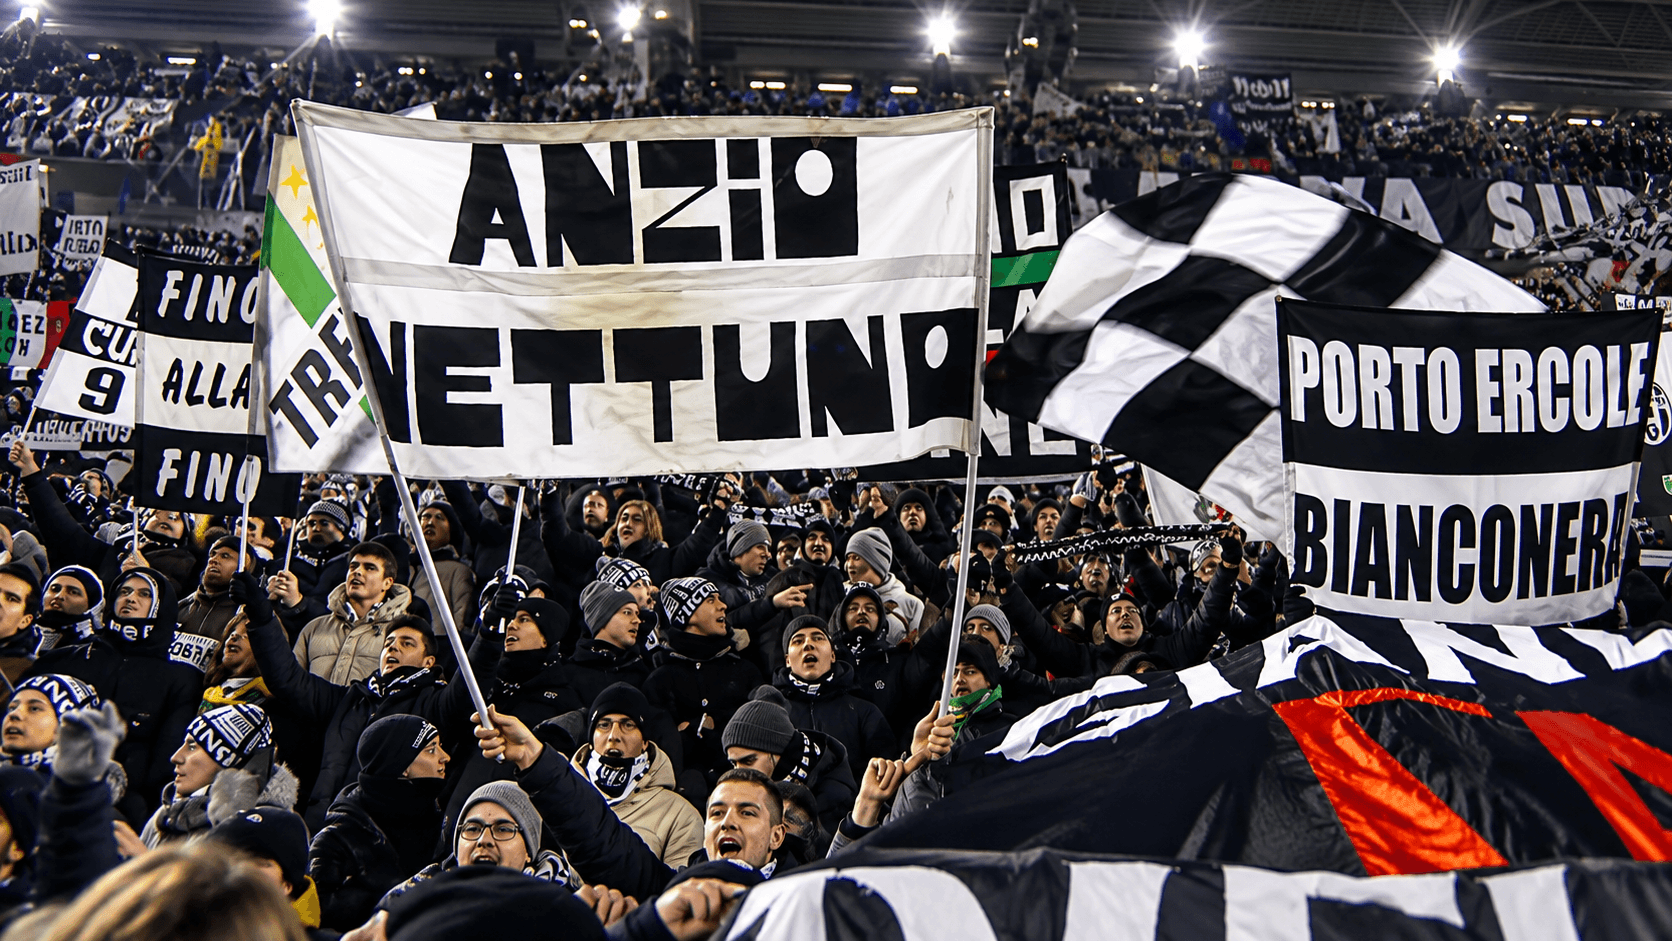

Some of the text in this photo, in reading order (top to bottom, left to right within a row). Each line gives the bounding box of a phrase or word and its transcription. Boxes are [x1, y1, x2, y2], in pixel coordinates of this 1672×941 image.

[157, 269, 259, 325] FINO
[78, 366, 126, 415] 9
[162, 357, 251, 409] ALLA
[353, 307, 979, 448] NETTUNO
[1287, 334, 1650, 435] PORTO ERCOLE
[156, 448, 261, 504] FINO
[1294, 491, 1630, 605] BIANCONERA
